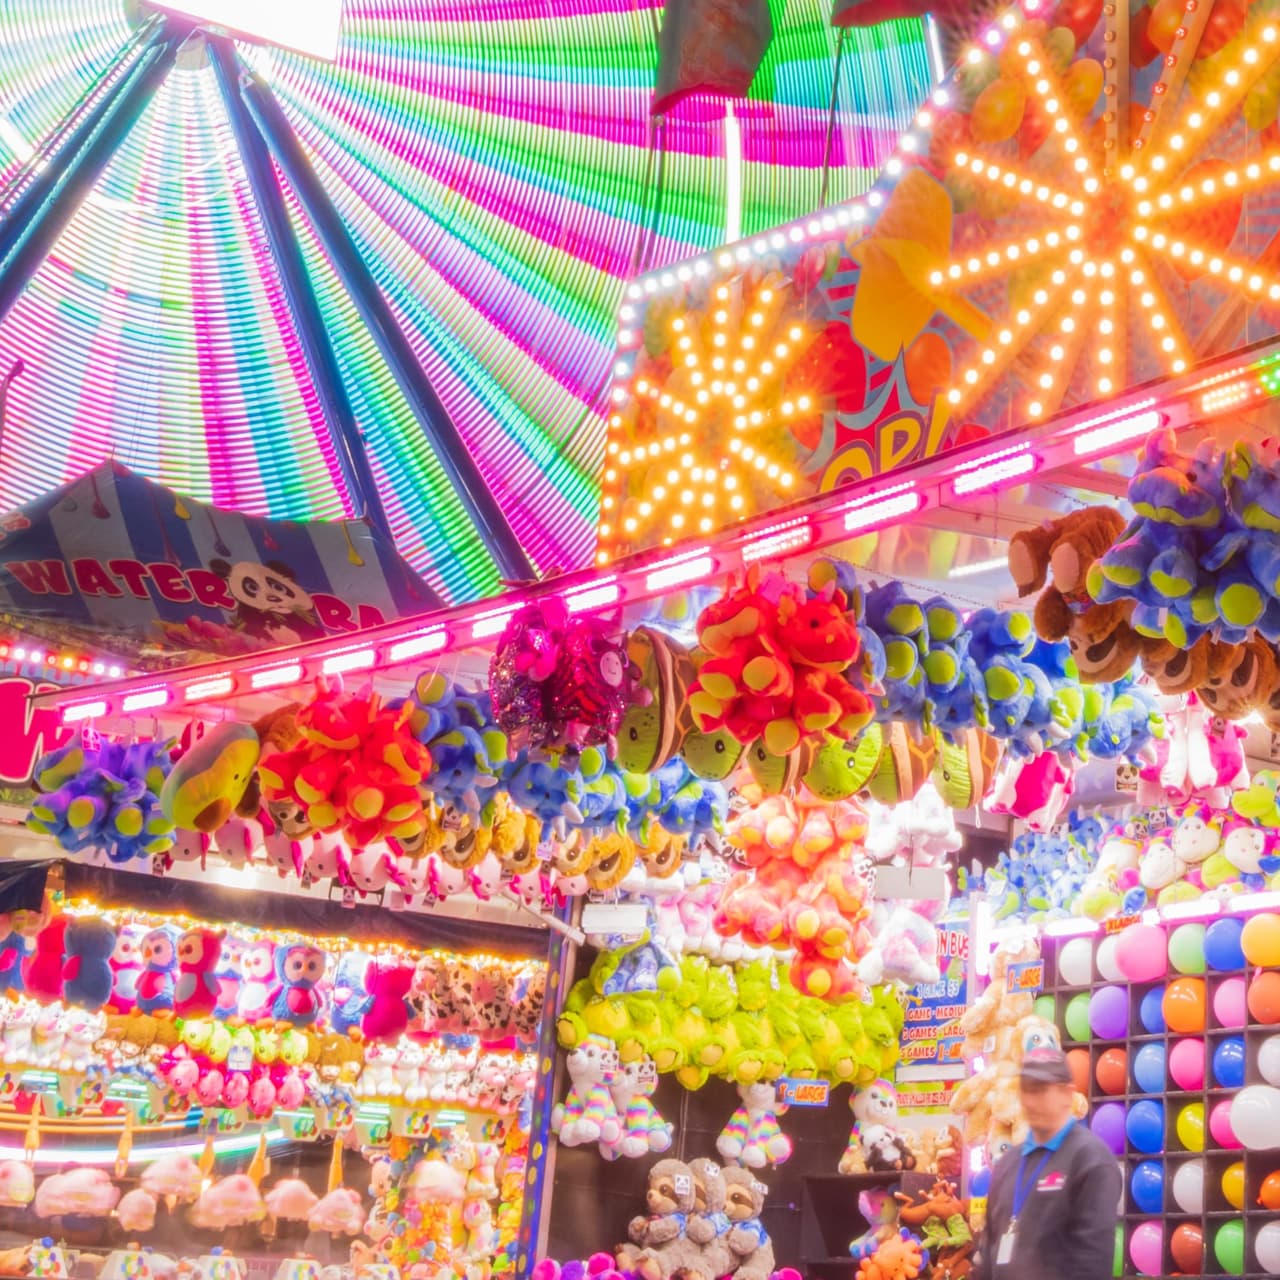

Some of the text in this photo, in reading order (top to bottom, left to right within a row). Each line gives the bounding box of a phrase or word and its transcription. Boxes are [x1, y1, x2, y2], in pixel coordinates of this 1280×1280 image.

[3, 557, 238, 611] WATER
[908, 1007, 931, 1021] GAME
[909, 1026, 937, 1039] GAMES
[907, 1046, 936, 1059] GAMES
